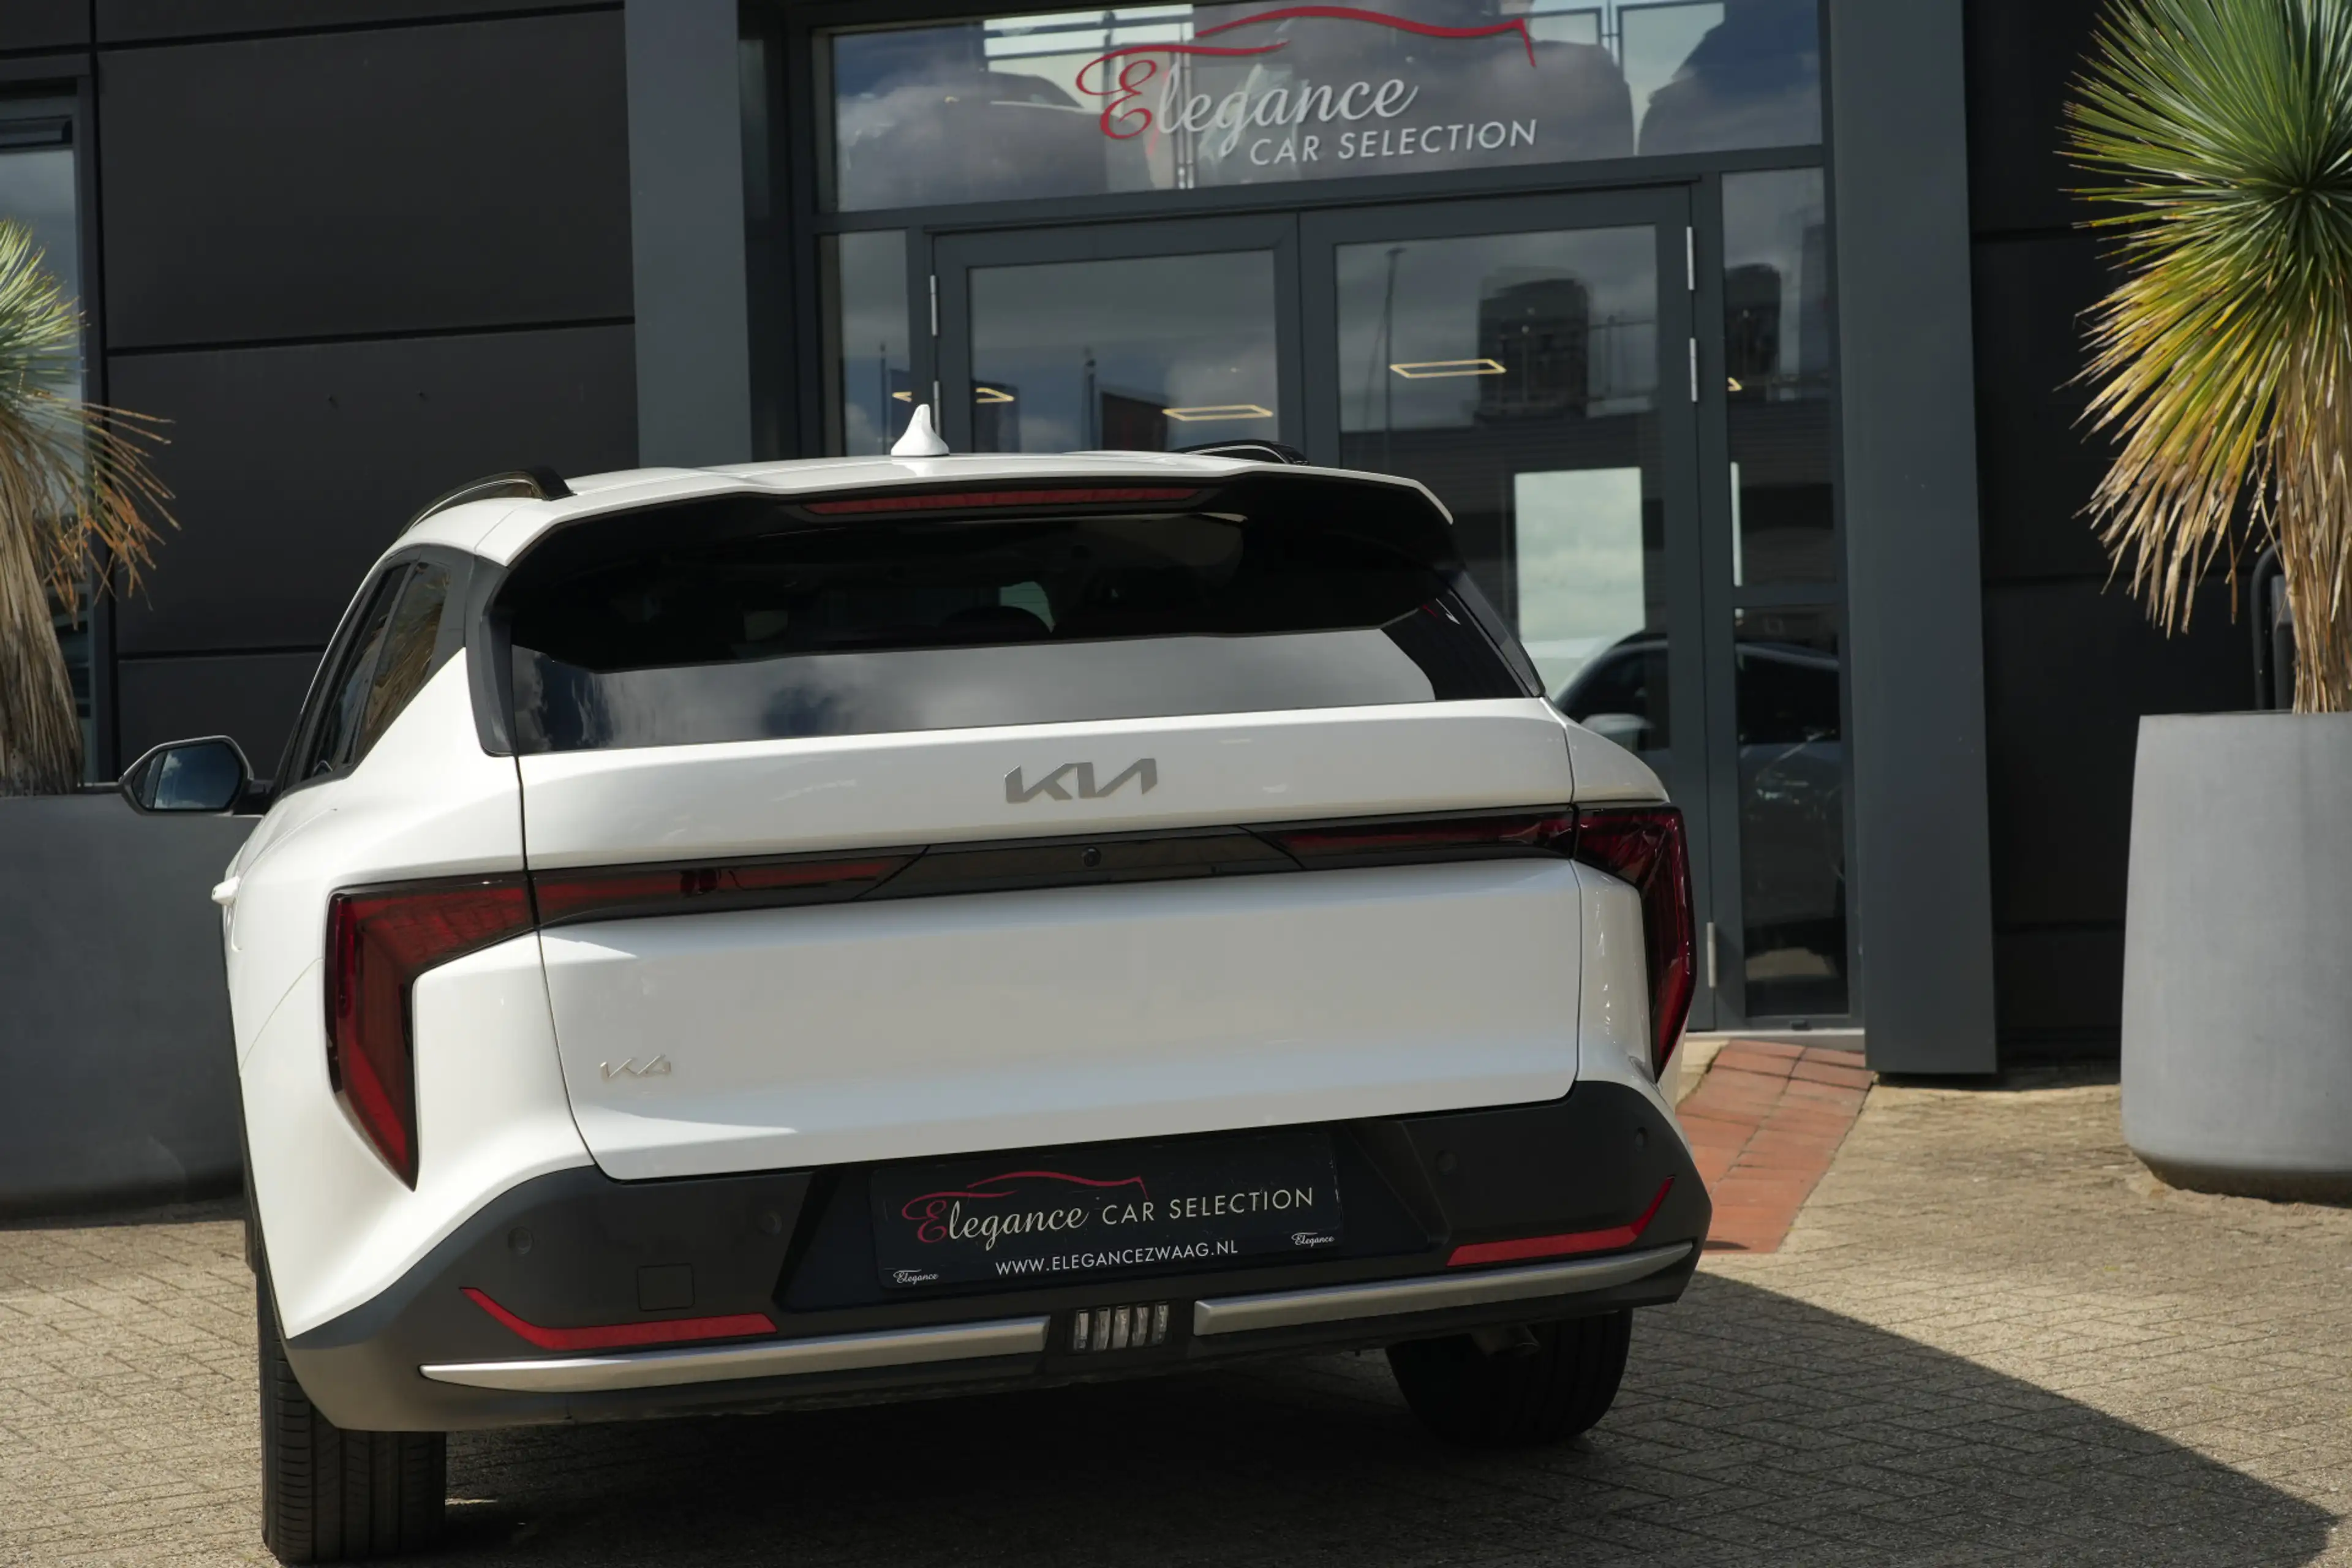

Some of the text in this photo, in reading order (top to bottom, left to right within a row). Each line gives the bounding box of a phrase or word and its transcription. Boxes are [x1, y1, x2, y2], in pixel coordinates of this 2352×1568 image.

[1076, 40, 1419, 158] Elegance
[1250, 119, 1538, 166] CAR SELECTION
[1005, 758, 1158, 804] KIA
[902, 1187, 1314, 1251] Elegance CAR SELECTION
[1291, 1232, 1335, 1247] Elegance
[892, 1269, 939, 1285] Elegance
[995, 1239, 1238, 1276] WWW.ELEGANCEZWAAG.NL
